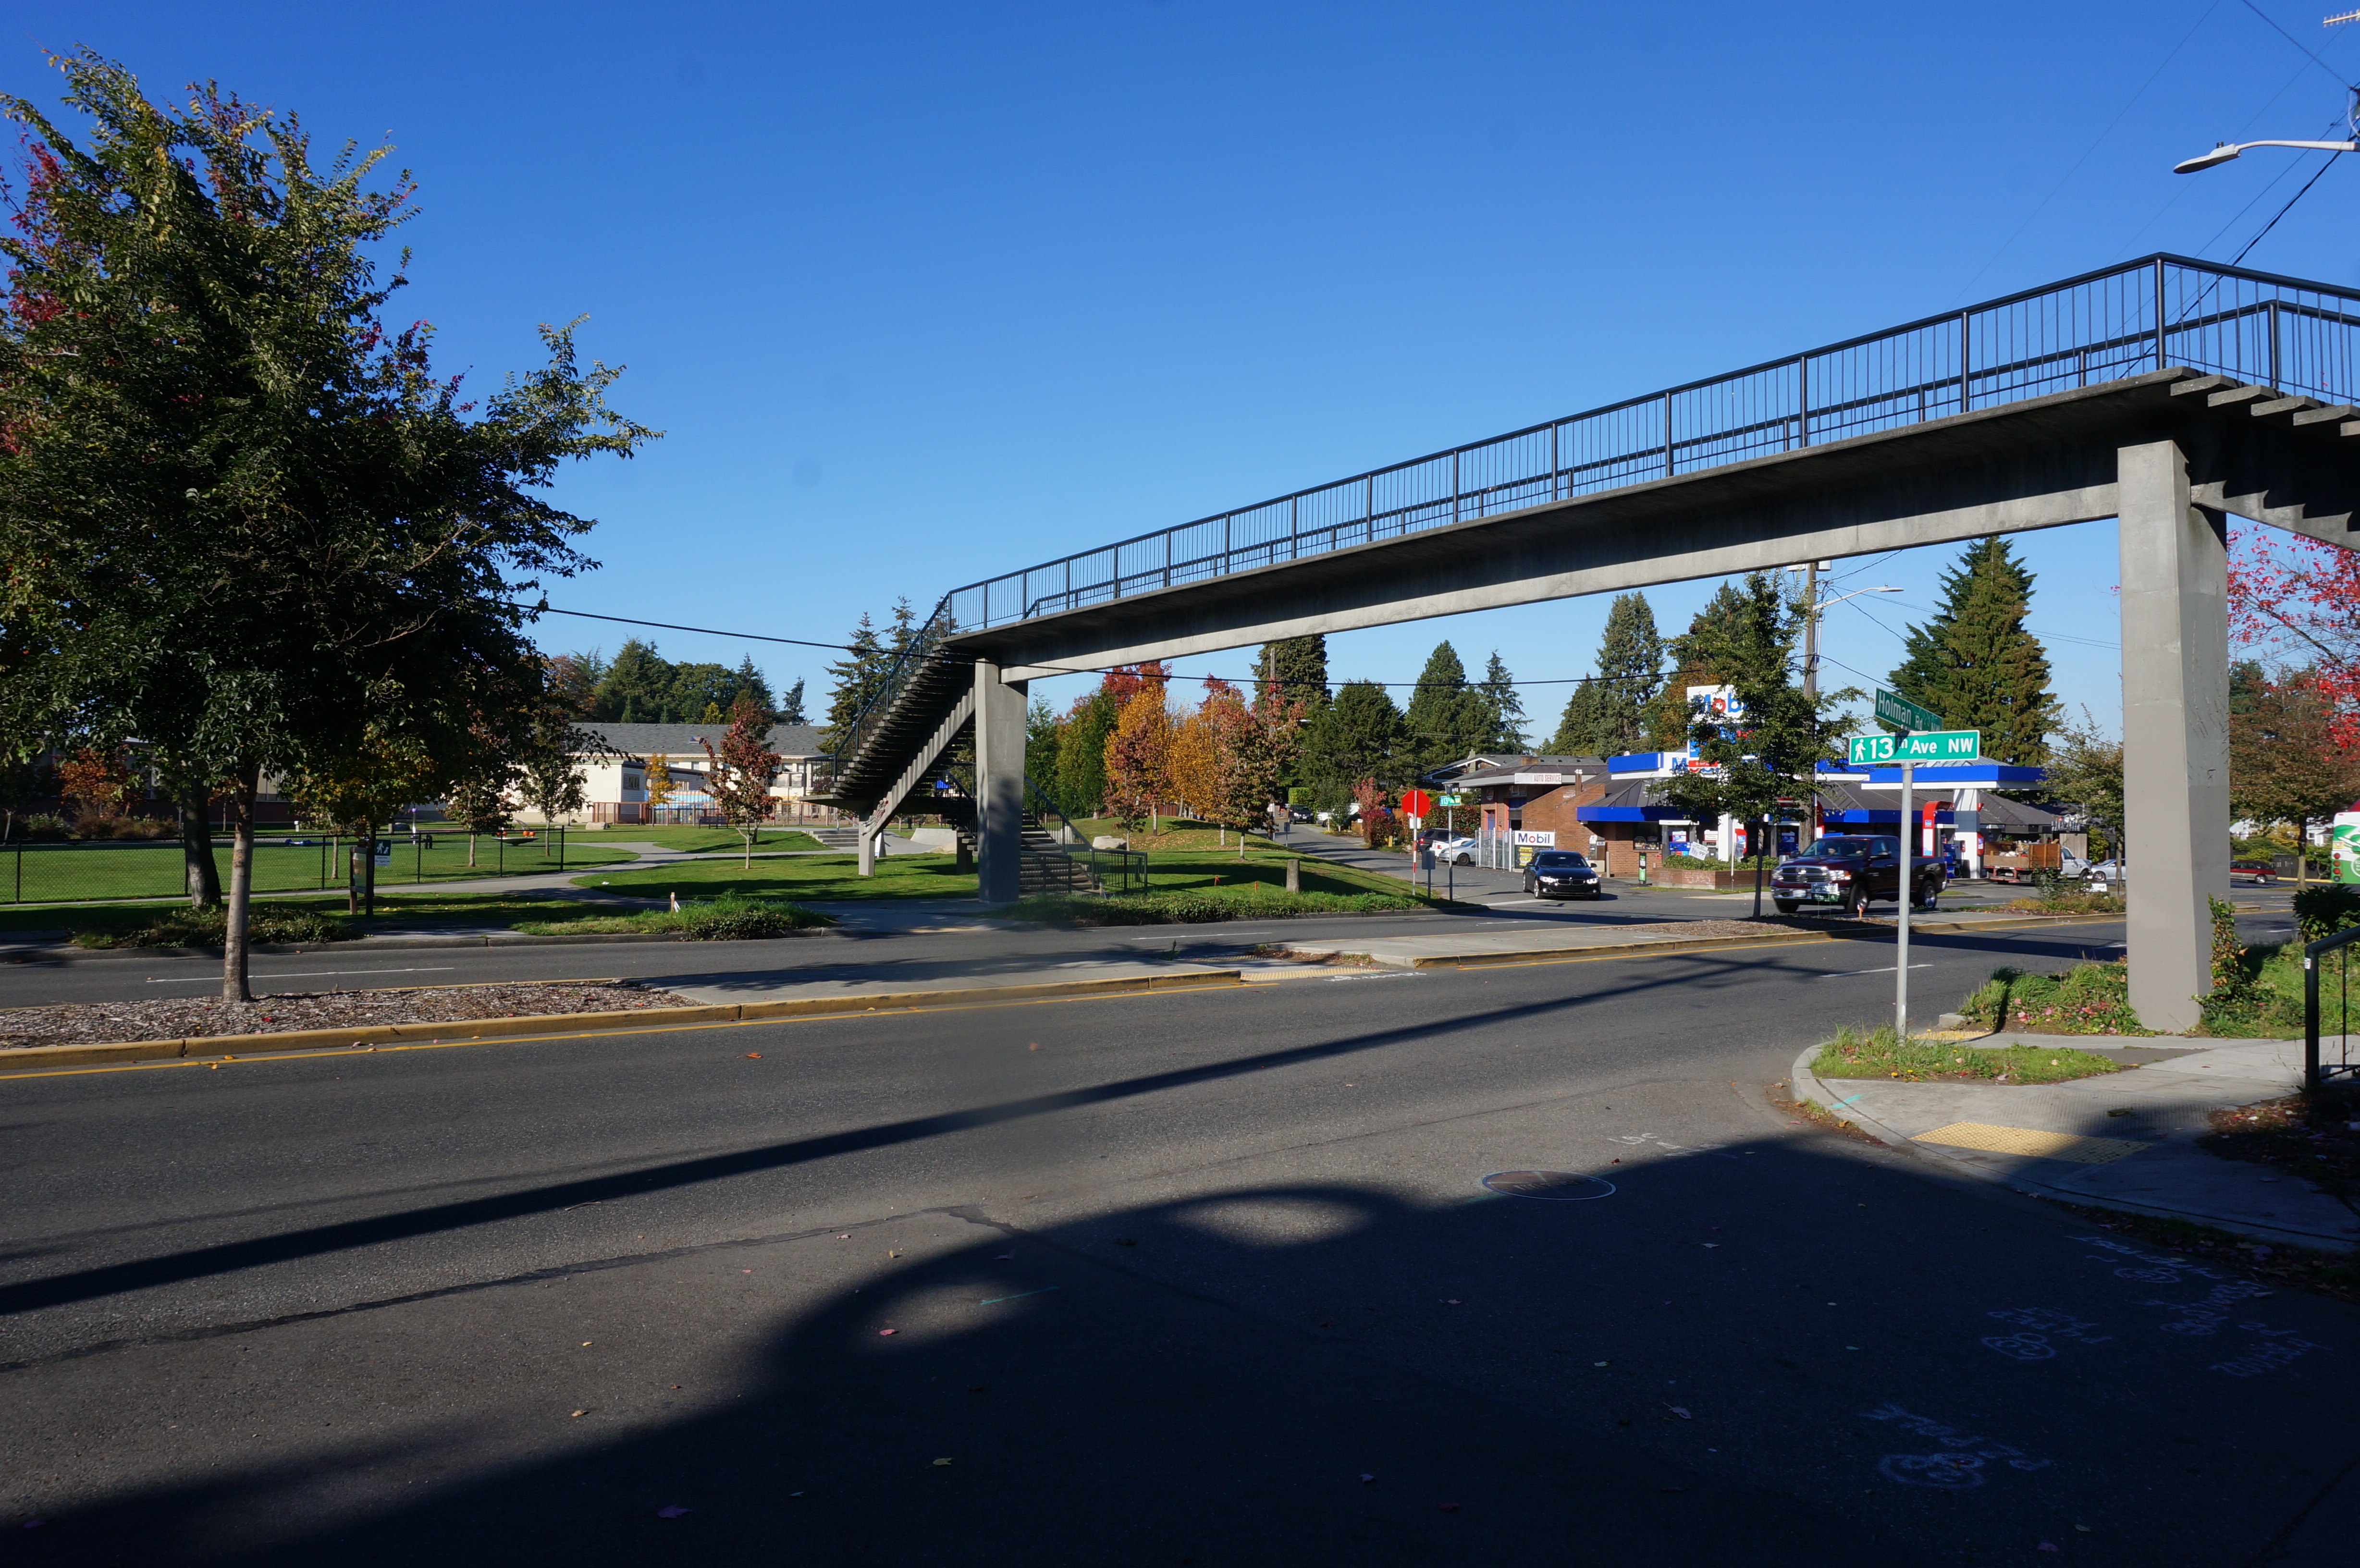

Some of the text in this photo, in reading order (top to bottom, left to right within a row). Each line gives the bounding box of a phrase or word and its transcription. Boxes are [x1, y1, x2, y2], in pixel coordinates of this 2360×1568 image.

[1693, 693, 1747, 713] Mob
[1878, 691, 1912, 725] Holman
[1915, 715, 1922, 731] Rd
[1910, 739, 1937, 754] Ave
[1948, 738, 1974, 753] NW
[1518, 833, 1550, 844] Mobil
